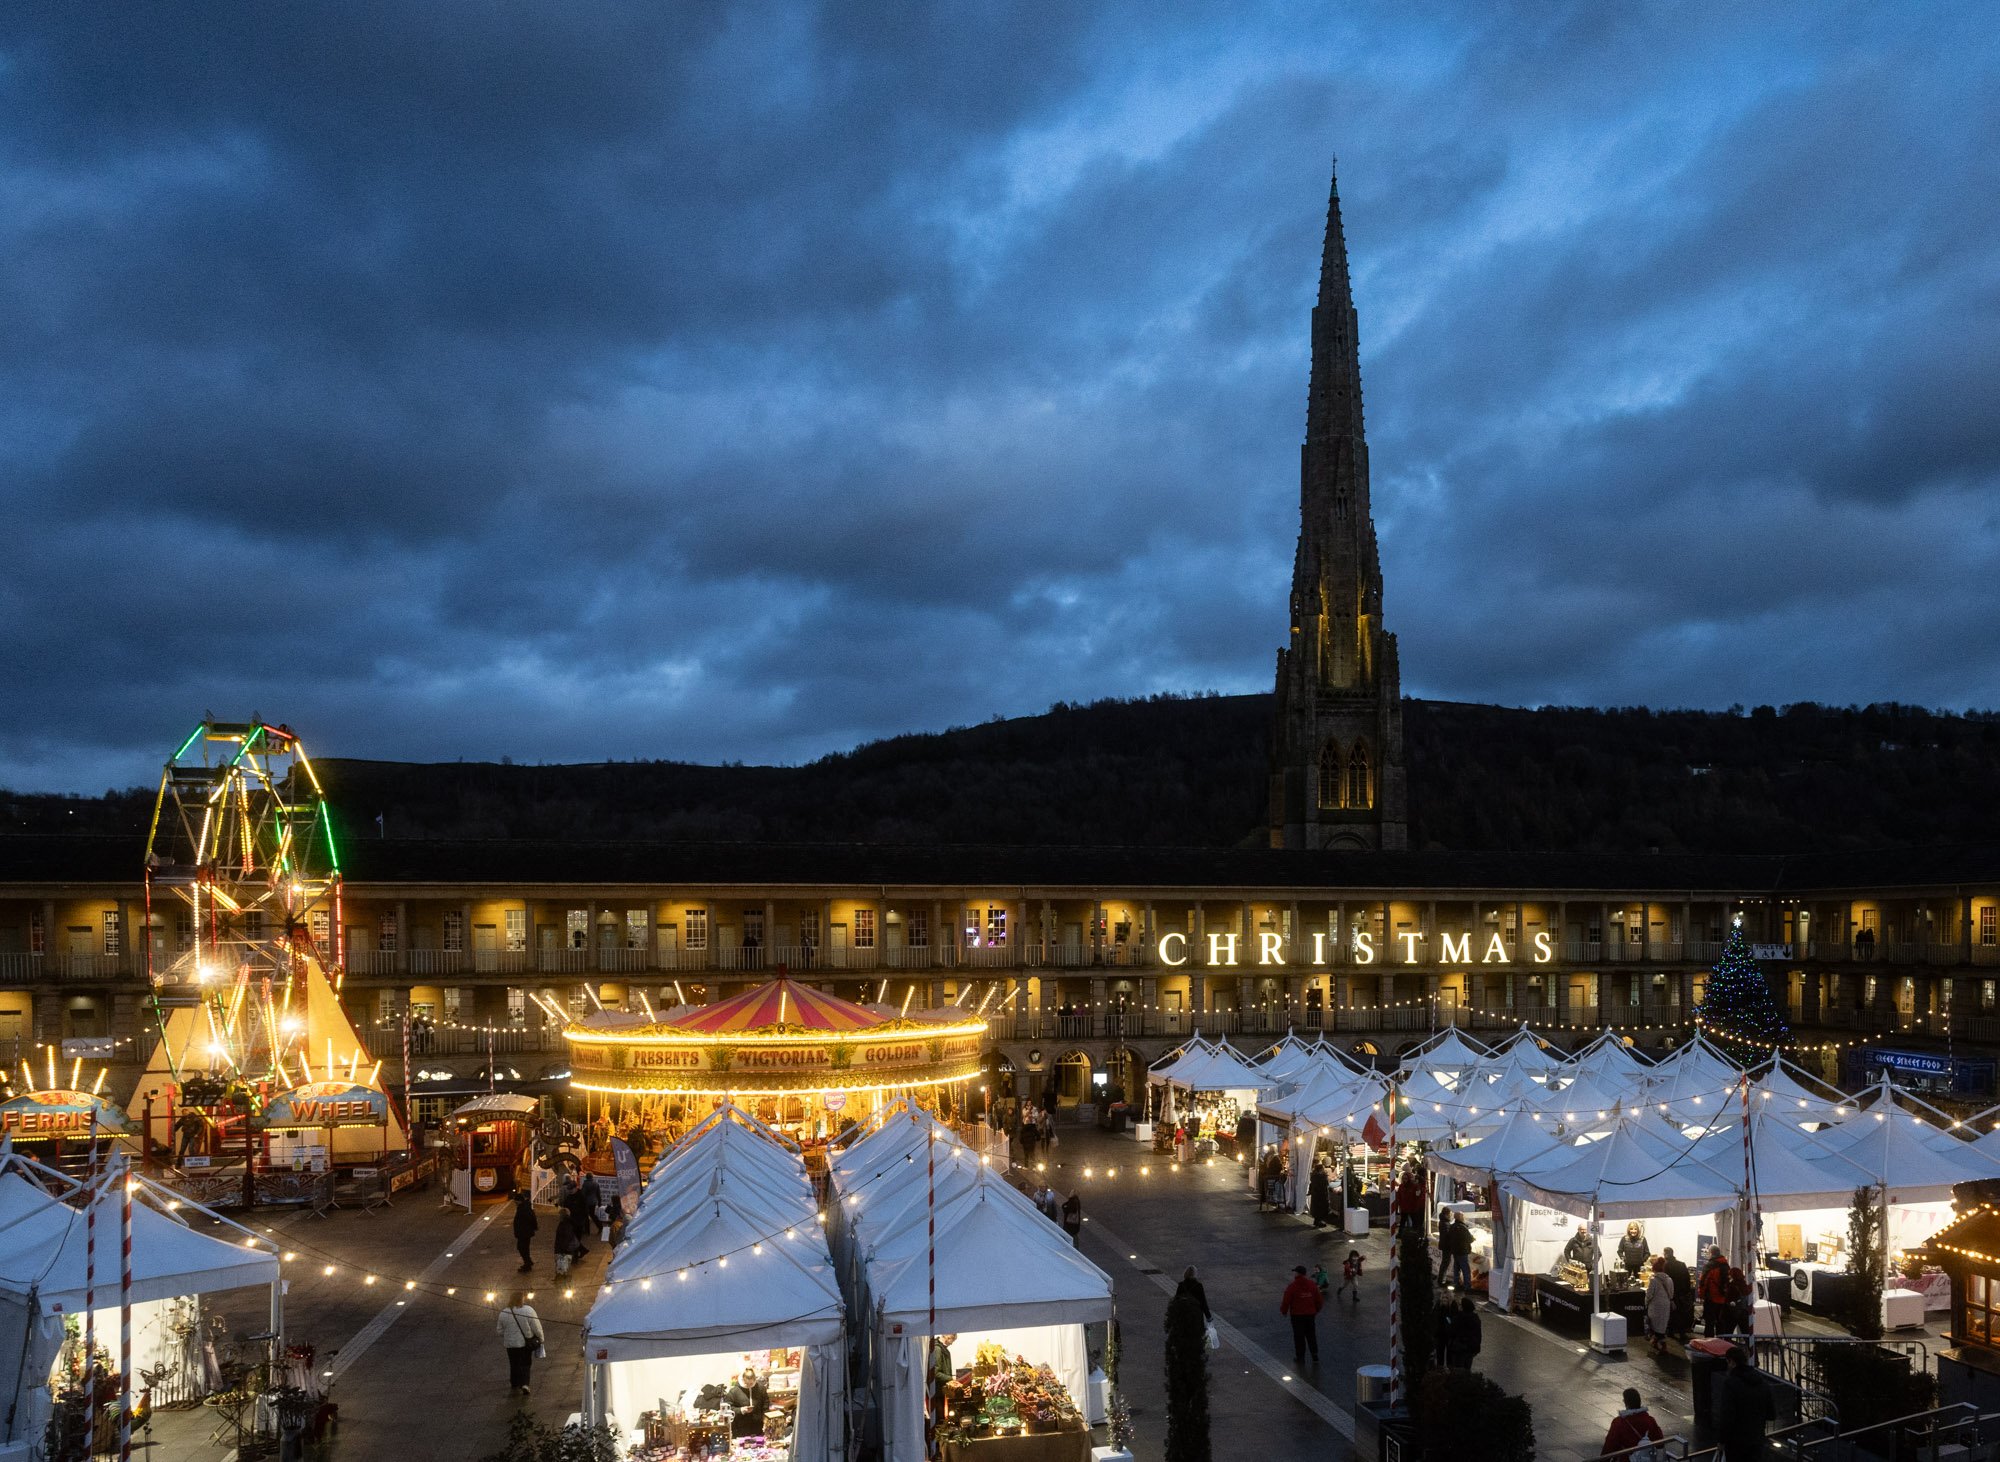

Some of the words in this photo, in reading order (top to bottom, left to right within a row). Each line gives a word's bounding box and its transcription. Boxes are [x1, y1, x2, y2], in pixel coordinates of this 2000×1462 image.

[1158, 932, 1553, 966] CHRISTMAS
[633, 1050, 700, 1067] PRESENTS
[737, 1050, 829, 1067] VICTORIAN
[866, 1046, 921, 1062] GOLDEN
[1875, 1053, 1896, 1064] GREEK
[1896, 1056, 1921, 1068] STREET
[1921, 1060, 1942, 1070] FOOD
[1, 1110, 92, 1133] FERRIS
[289, 1100, 379, 1122] WHEEL
[471, 1111, 531, 1124] ENTRANCE
